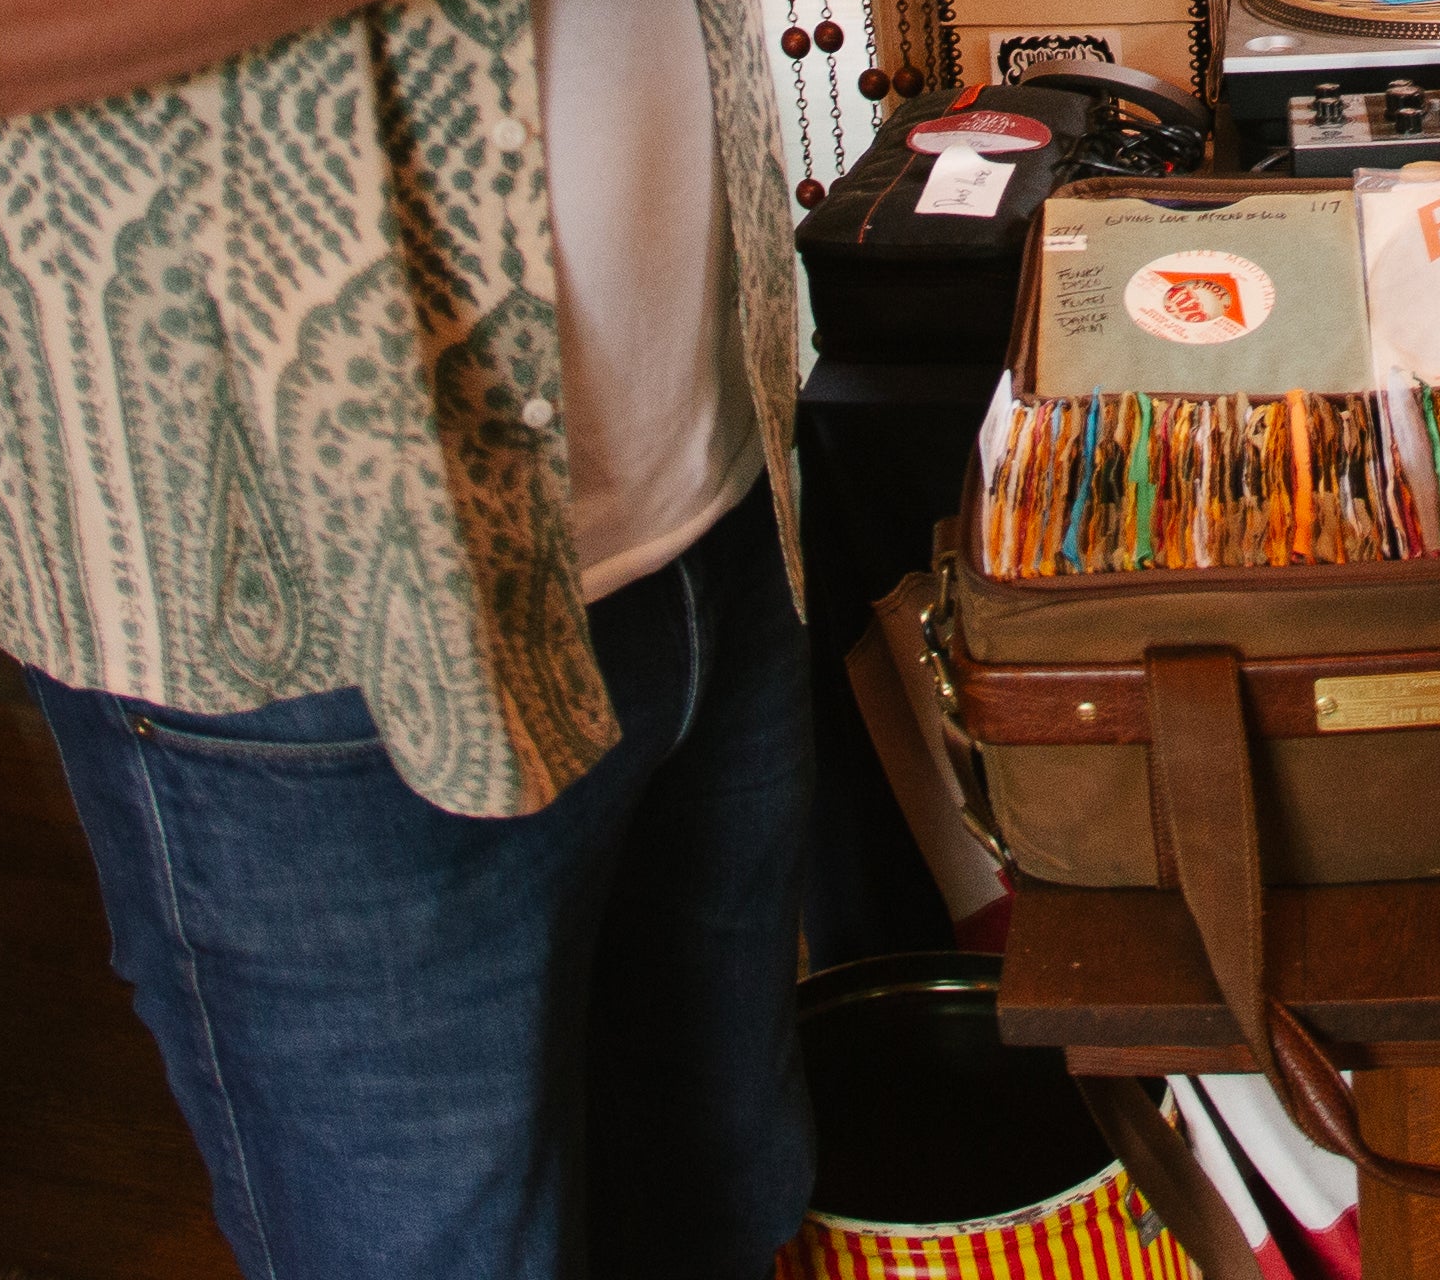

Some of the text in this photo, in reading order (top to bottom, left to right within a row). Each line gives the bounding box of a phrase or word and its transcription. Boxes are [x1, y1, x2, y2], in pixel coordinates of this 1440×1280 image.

[1310, 200, 1343, 215] 117
[1159, 213, 1190, 225] LOVE
[1049, 224, 1085, 238] 374
